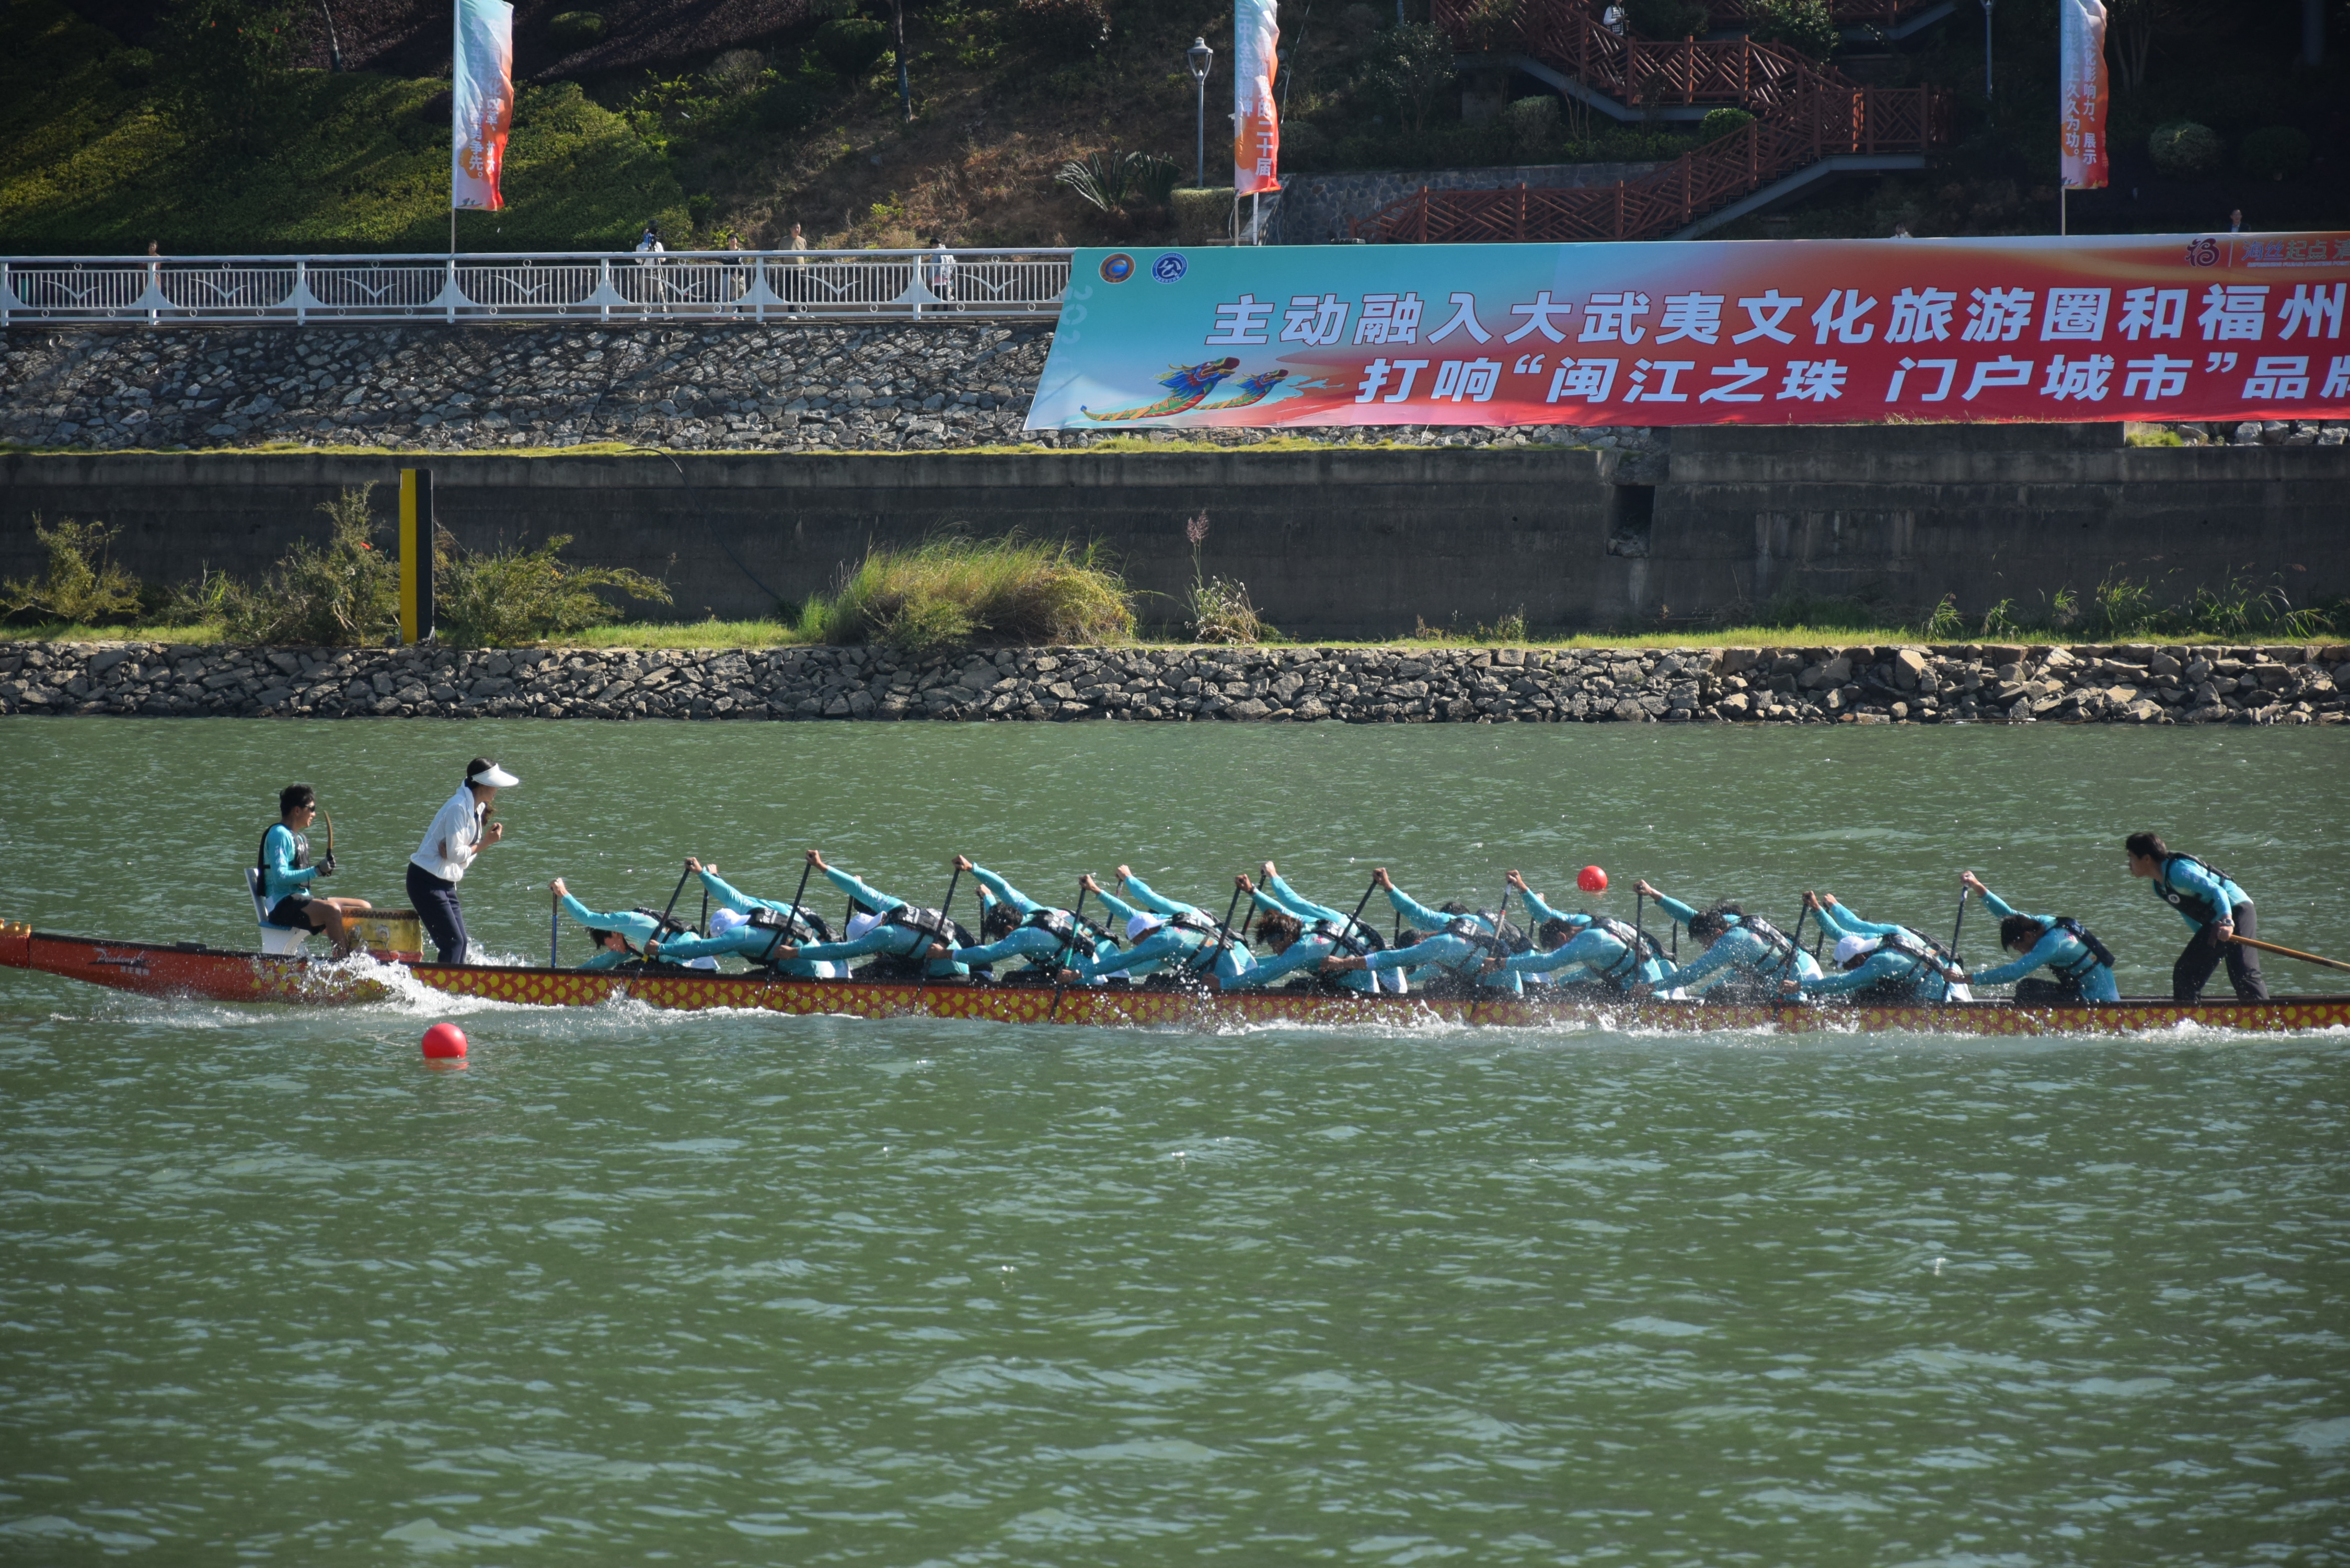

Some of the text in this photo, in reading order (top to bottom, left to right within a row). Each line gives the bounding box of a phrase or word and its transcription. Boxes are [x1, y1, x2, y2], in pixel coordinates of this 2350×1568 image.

[2082, 132, 2097, 165] 展示
[2241, 239, 2328, 261] 海丝起点
[1204, 283, 2347, 347] 主动融入大武夷文化旅游圈和福州
[1354, 352, 1849, 403] 打响“闽江之珠
